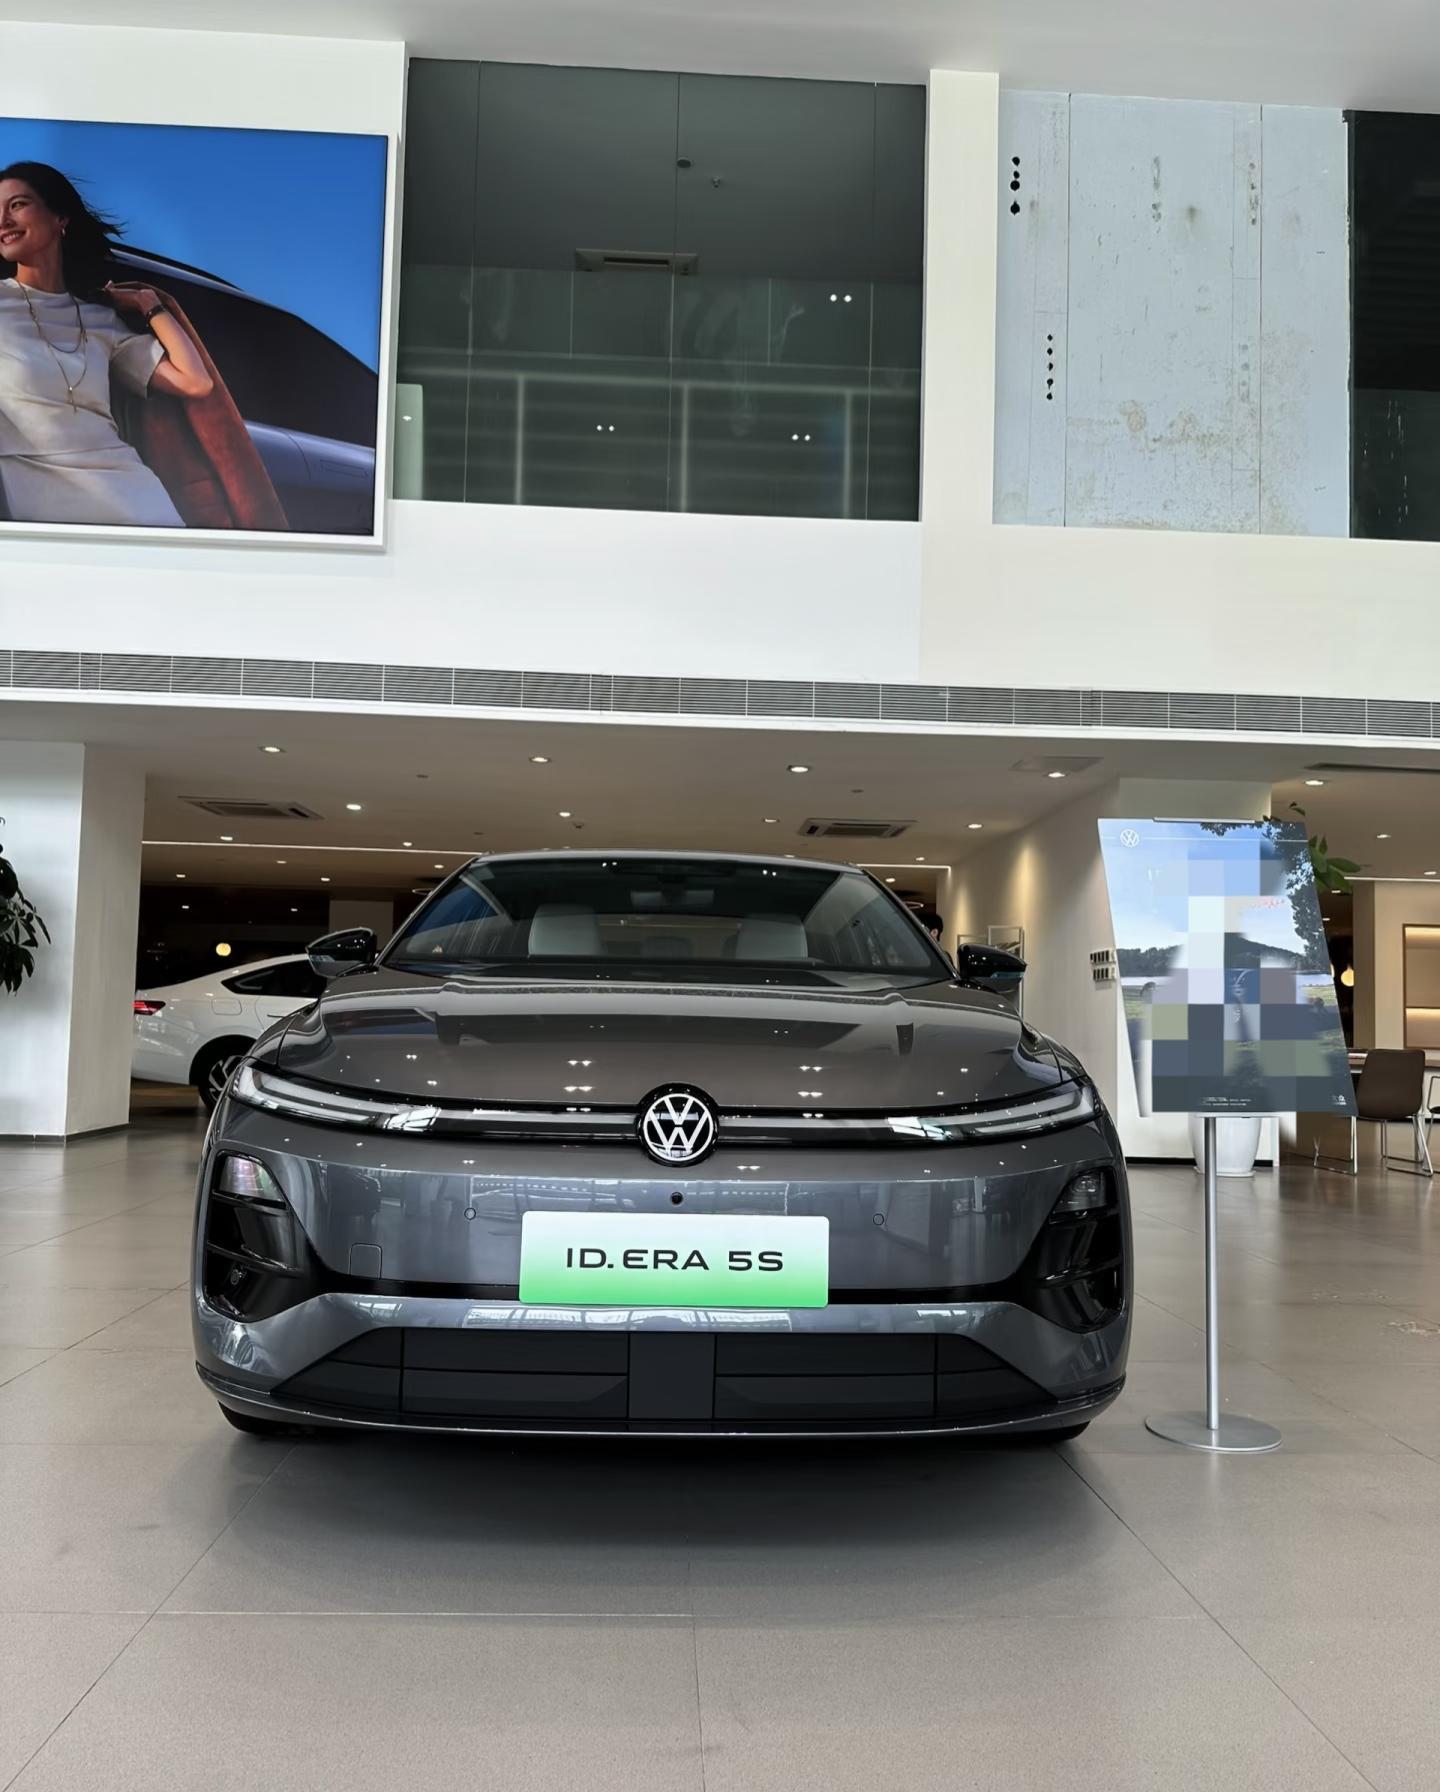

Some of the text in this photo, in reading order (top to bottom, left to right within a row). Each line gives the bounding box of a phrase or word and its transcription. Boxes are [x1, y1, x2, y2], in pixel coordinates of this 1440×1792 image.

[644, 1093, 713, 1161] VW
[566, 1247, 784, 1272] ID.ERA 5S
